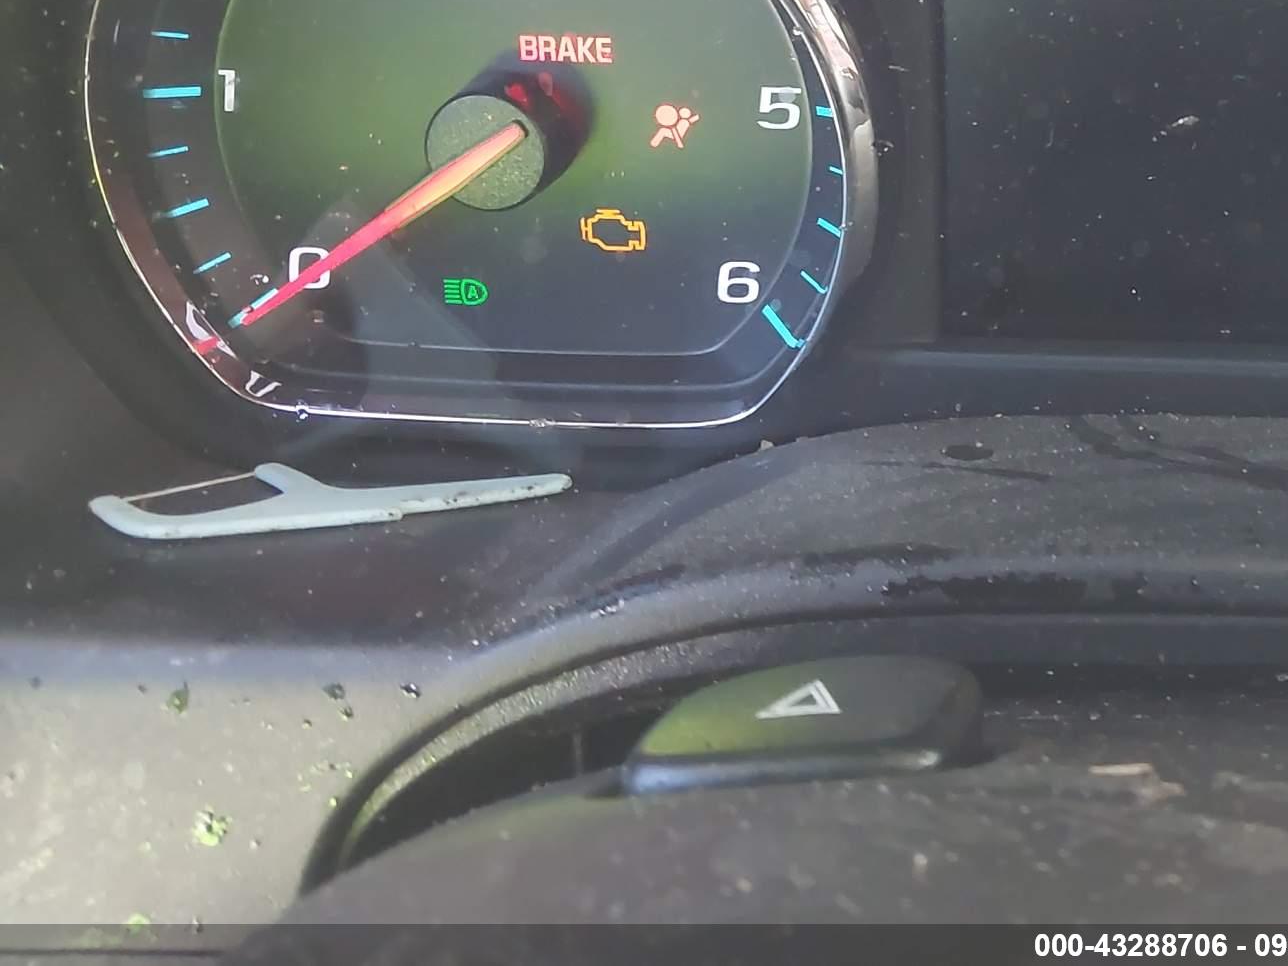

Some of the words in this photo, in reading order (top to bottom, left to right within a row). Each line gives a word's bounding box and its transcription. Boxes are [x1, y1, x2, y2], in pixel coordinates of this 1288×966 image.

[519, 35, 613, 64] BRAKE
[217, 69, 237, 112] 1
[756, 86, 802, 130] 5
[288, 246, 331, 289] 0
[717, 261, 761, 304] 6
